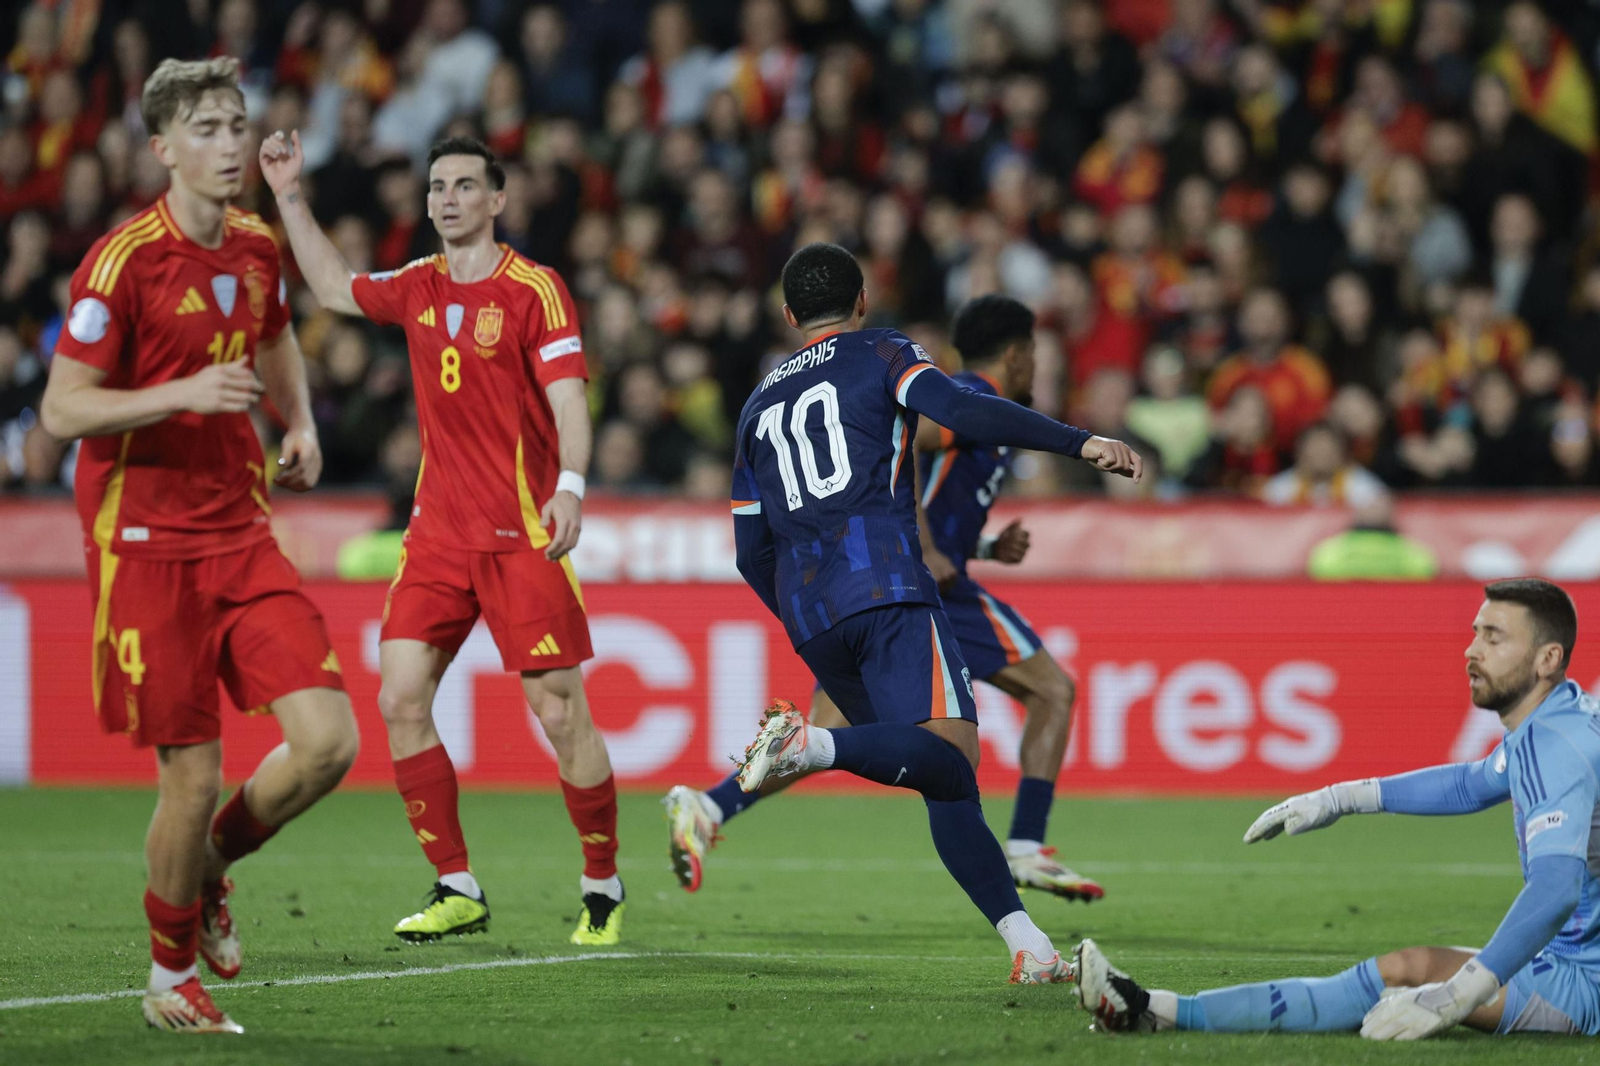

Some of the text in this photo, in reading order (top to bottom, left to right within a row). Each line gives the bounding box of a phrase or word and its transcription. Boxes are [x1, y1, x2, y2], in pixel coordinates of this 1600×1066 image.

[440, 345, 461, 394] 8
[761, 338, 838, 392] MEMPHIS
[755, 380, 853, 512] 10
